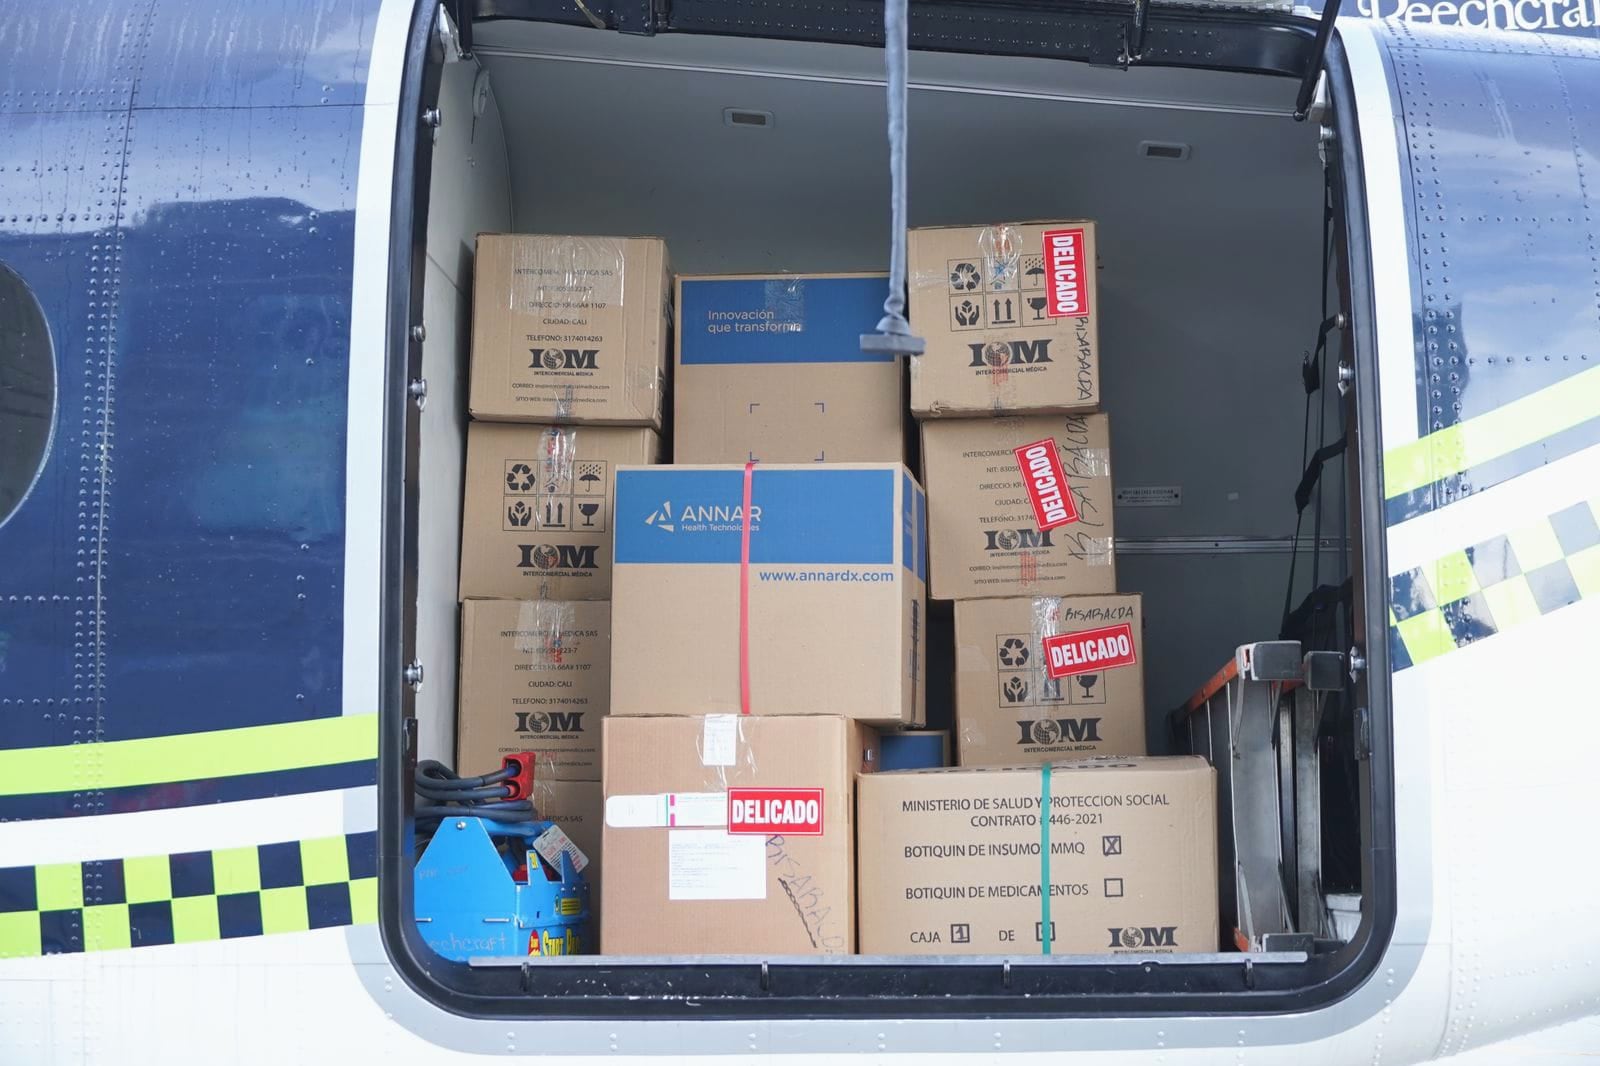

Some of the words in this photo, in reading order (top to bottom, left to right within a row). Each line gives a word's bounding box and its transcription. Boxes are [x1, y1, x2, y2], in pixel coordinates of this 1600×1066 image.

[1052, 235, 1079, 313] DELICADO
[708, 309, 775, 320] Innovación
[708, 323, 731, 334] que
[976, 367, 1025, 376] INTERCOMERCIAL
[1025, 446, 1067, 523] DELICADO
[681, 505, 762, 522] ANNAR
[682, 523, 707, 531] Health
[709, 523, 760, 531] Technoloes
[759, 570, 894, 583] www.annardx.com
[1050, 634, 1131, 668] DELICADO
[1024, 745, 1073, 753] INTERCOMERCIAL
[902, 798, 971, 812] MINISTERIO
[973, 798, 990, 810] DE
[992, 797, 1033, 810] SALUD
[1035, 797, 1042, 808] Y
[1126, 794, 1170, 806] SOCIAL
[732, 800, 819, 824] DELICADO
[970, 814, 1036, 827] CONTRATO
[1040, 813, 1103, 826] 446-2021
[904, 844, 966, 858] BOTIQUIN
[968, 844, 986, 856] DE
[988, 843, 1042, 856] INSUMO
[1051, 842, 1085, 855] MMQ
[905, 887, 966, 900] BOTIQUIN
[968, 886, 985, 898] DE
[910, 931, 941, 943] CAJA
[999, 930, 1015, 941] DE
